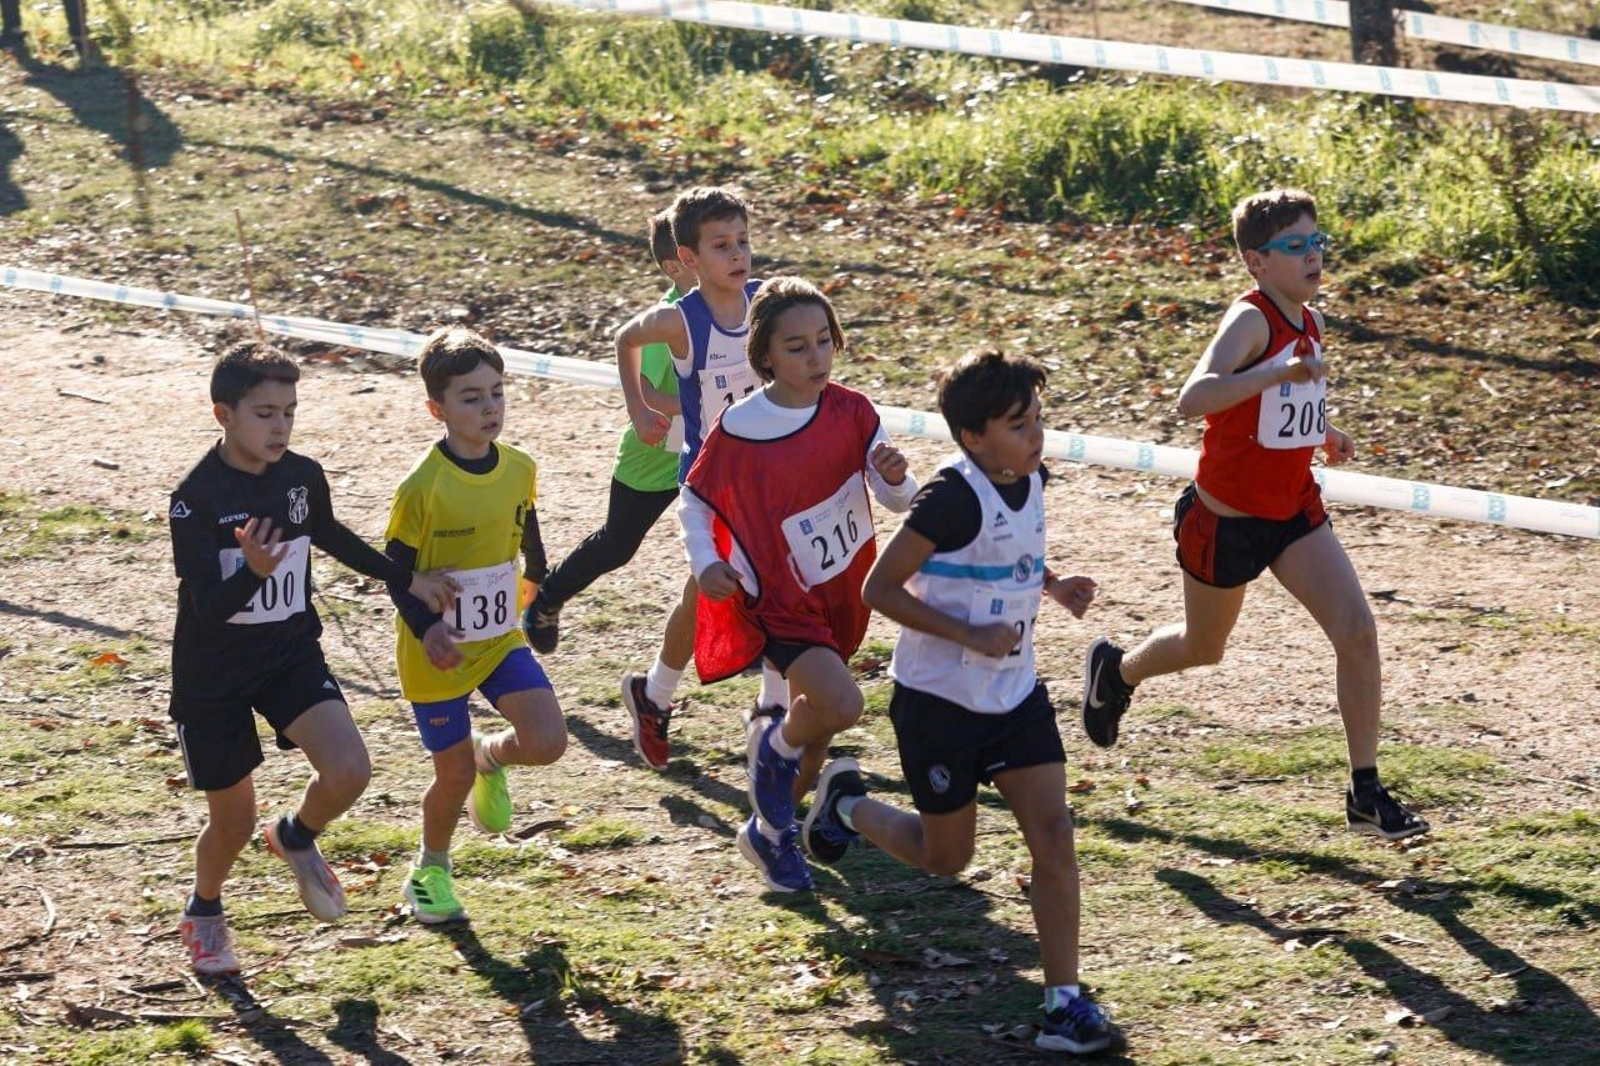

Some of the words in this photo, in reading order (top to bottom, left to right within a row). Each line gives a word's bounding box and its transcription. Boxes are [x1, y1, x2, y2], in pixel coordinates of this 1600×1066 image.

[1278, 398, 1326, 438] 208
[811, 509, 858, 571] 216
[245, 571, 295, 613] 00
[455, 590, 507, 631] 138
